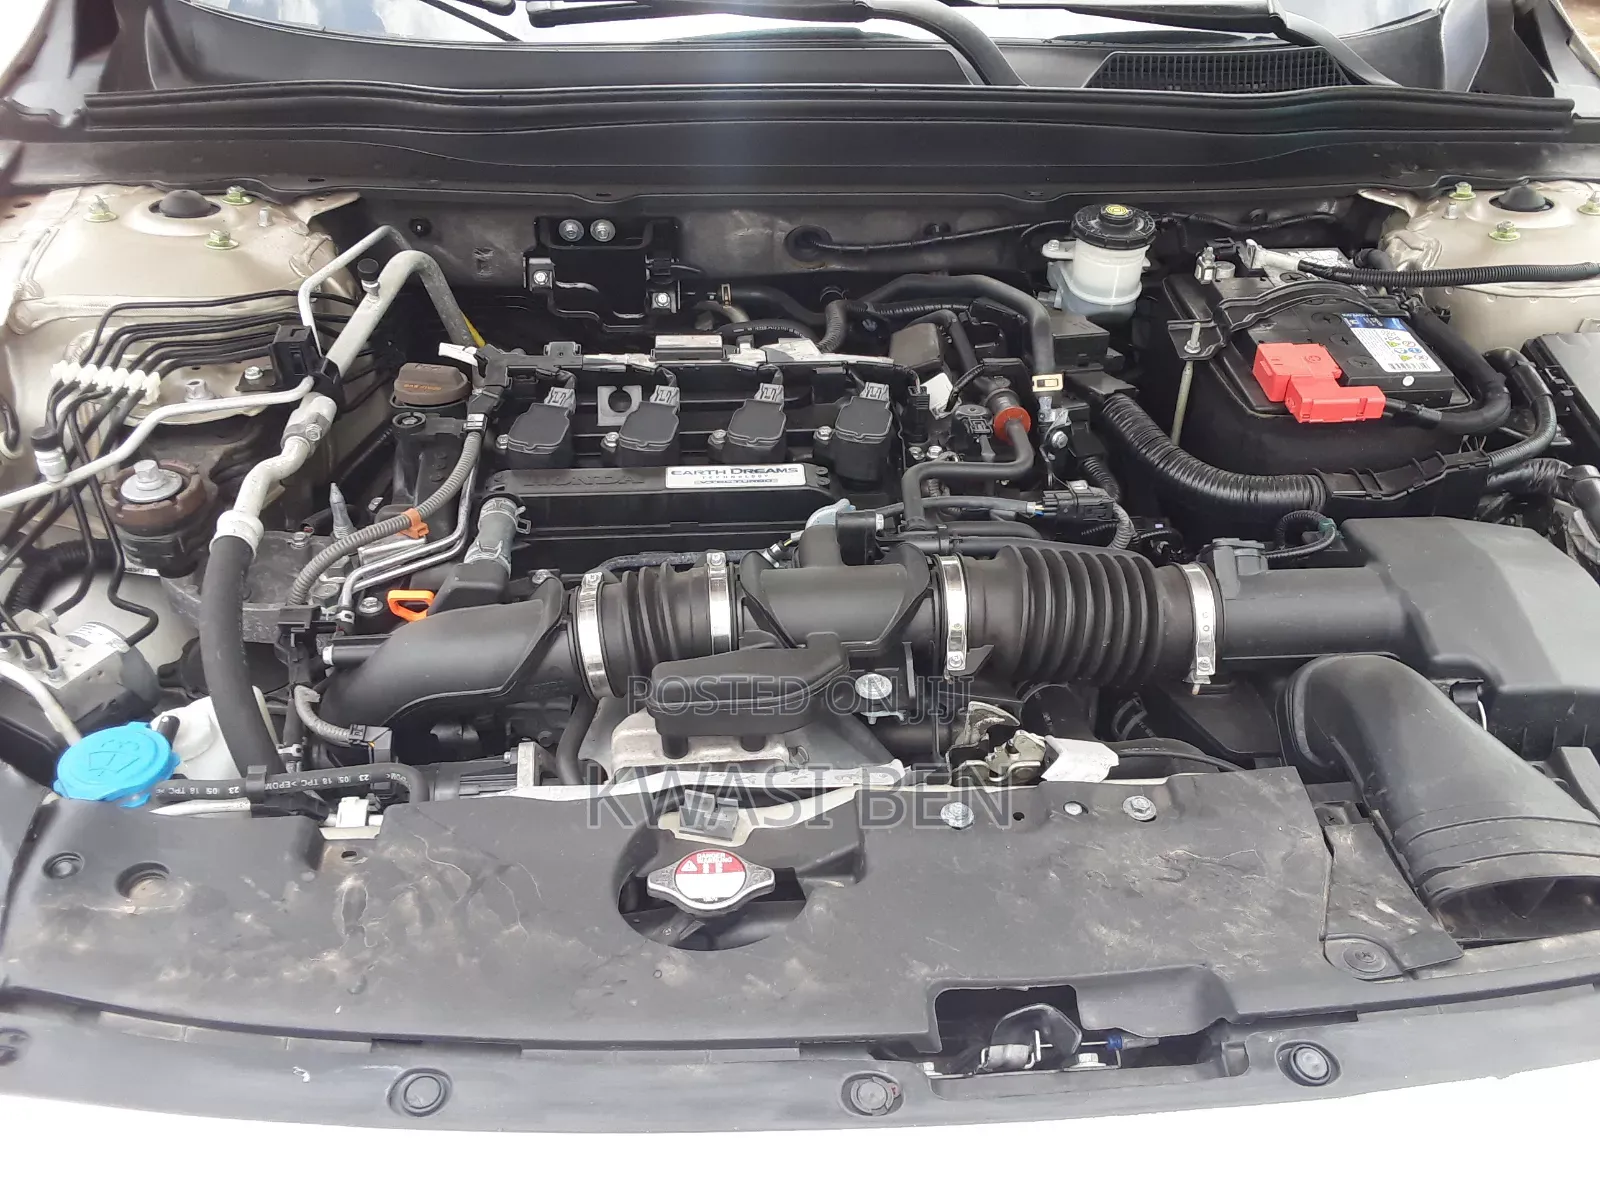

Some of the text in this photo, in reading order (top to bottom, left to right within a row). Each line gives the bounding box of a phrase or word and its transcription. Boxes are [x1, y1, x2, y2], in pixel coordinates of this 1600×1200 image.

[322, 776, 333, 785] 18
[359, 773, 370, 782] 23
[300, 778, 319, 787] TPC
[168, 786, 186, 795] TPC
[228, 785, 240, 795] 23
